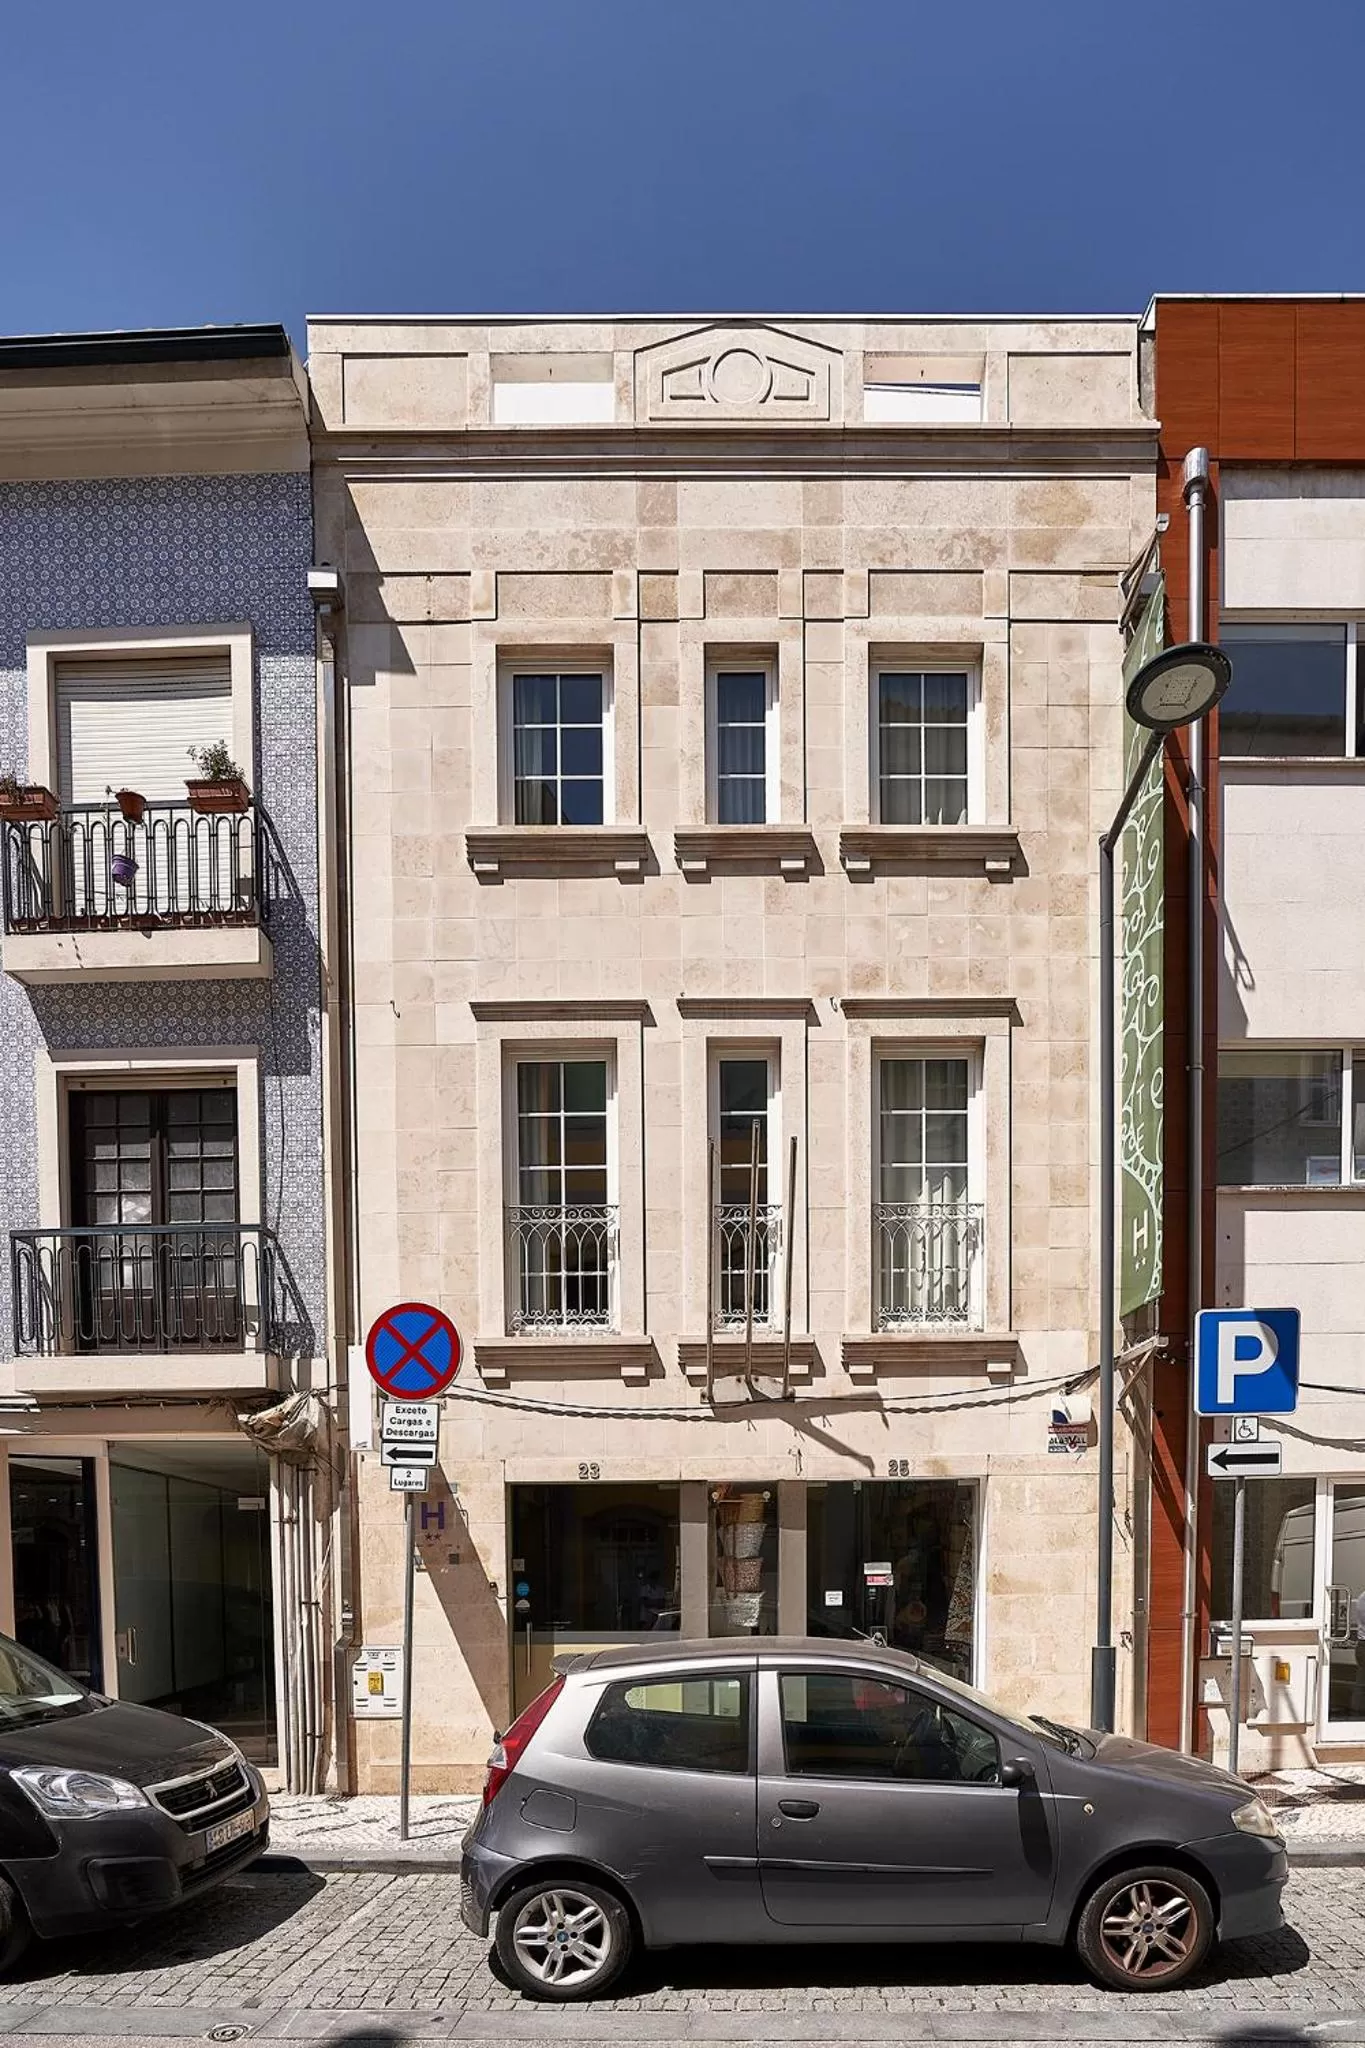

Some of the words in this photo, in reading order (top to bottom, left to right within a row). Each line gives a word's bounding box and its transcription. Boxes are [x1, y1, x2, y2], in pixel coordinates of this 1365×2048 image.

[1133, 1208, 1149, 1257] H
[1217, 1321, 1279, 1404] P
[395, 1406, 427, 1414] Exceto
[389, 1417, 423, 1426] Cargas
[386, 1428, 435, 1438] Descargas
[406, 1470, 412, 1478] 2
[578, 1462, 600, 1480] 23
[888, 1459, 910, 1477] 25
[394, 1479, 423, 1487] Lugares
[420, 1501, 445, 1530] H
